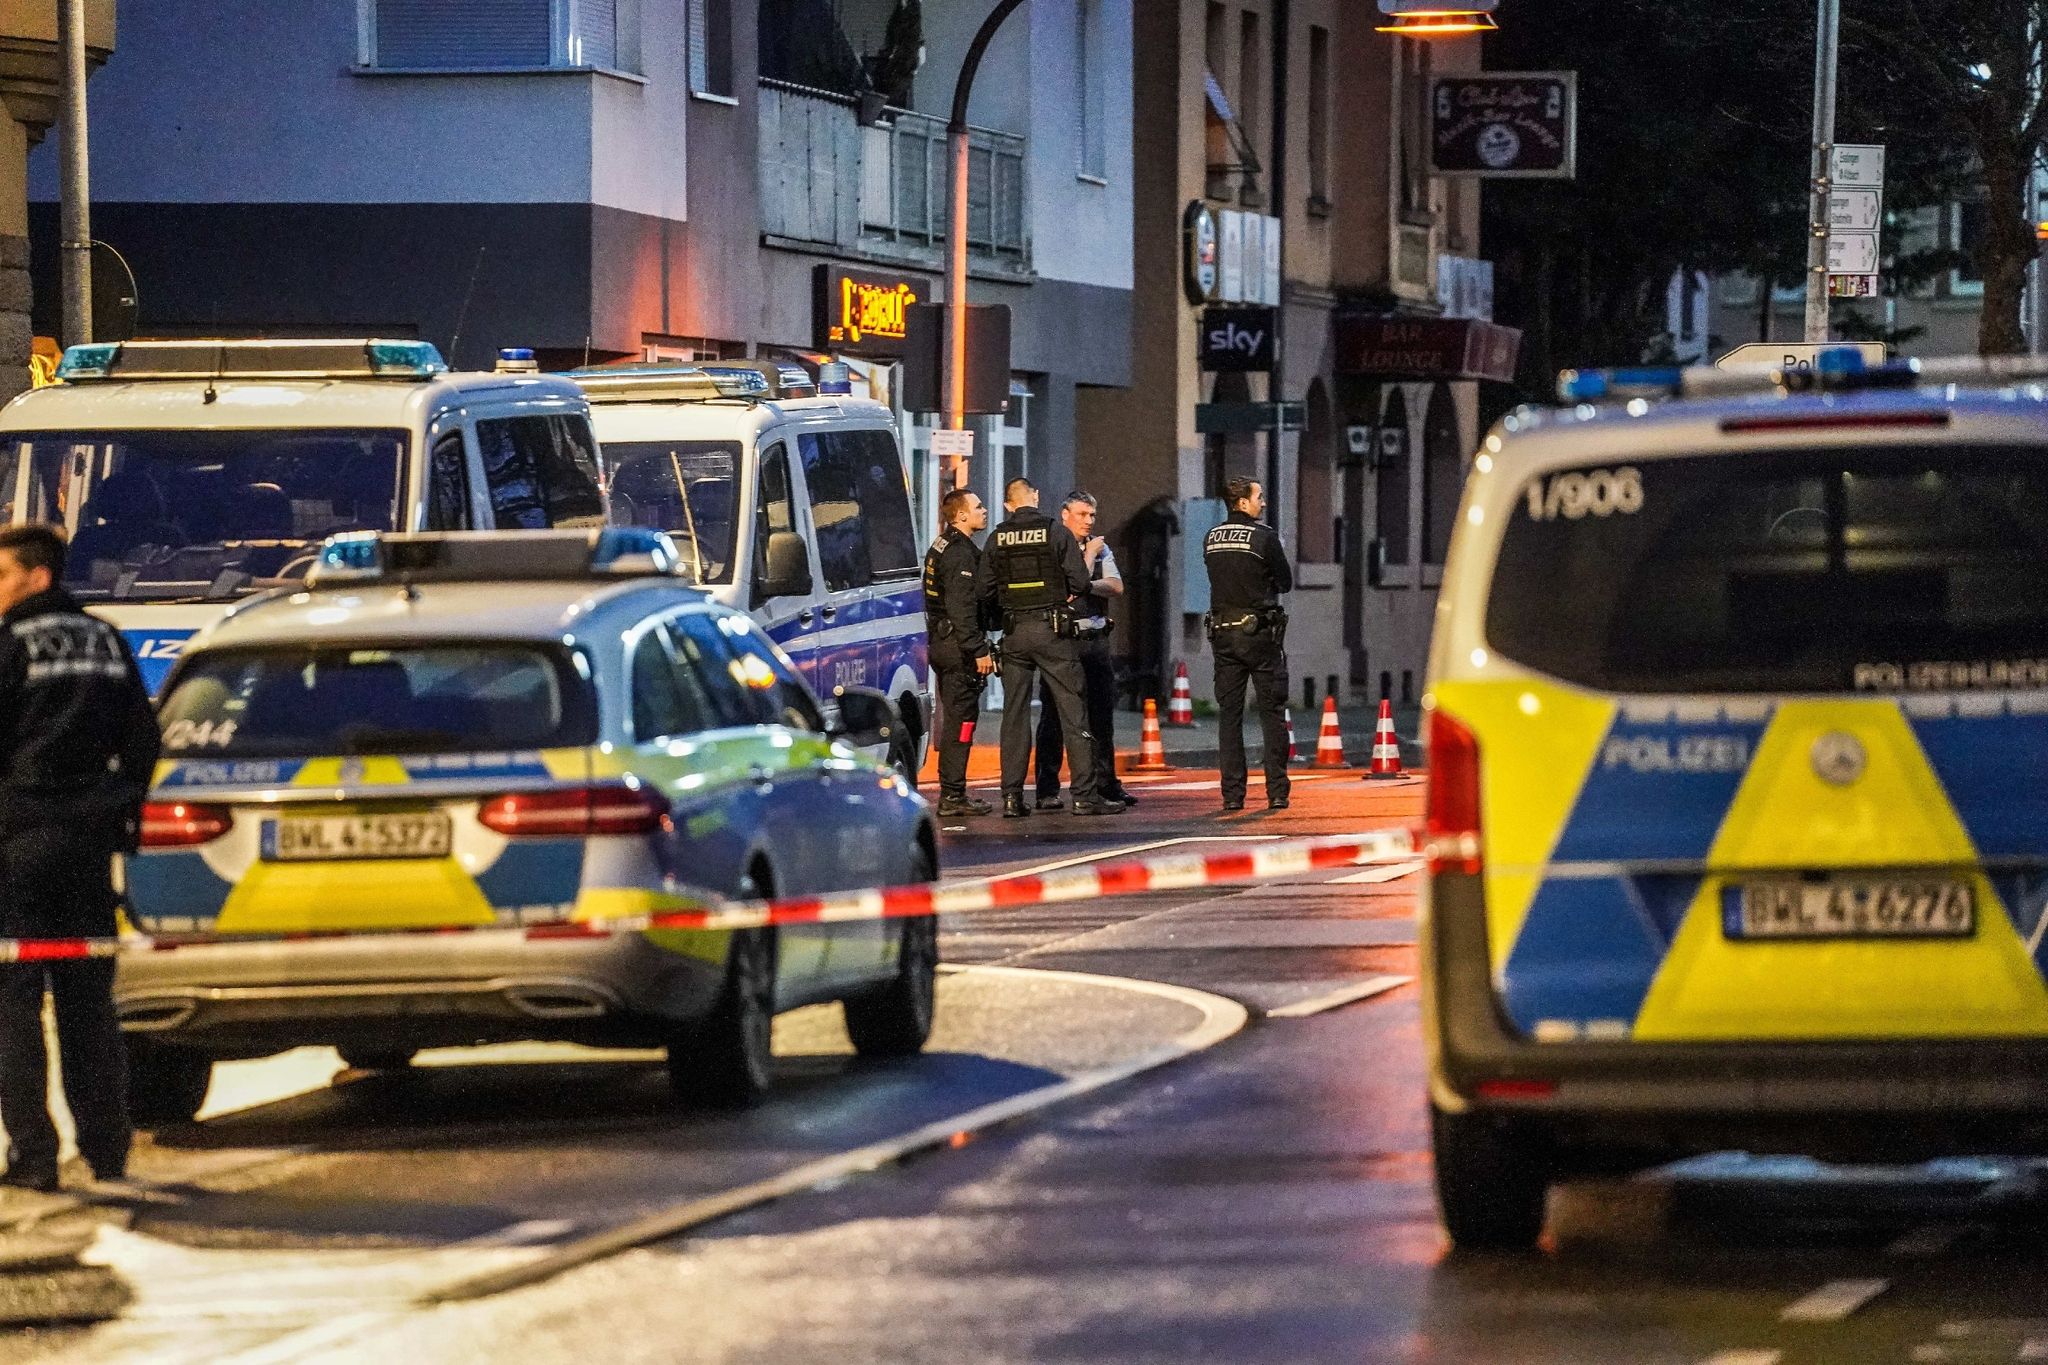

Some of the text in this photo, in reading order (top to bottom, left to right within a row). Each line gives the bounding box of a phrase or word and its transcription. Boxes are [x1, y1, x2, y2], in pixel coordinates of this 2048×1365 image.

[1209, 322, 1265, 357] sky
[1382, 323, 1424, 343] BAR
[1359, 347, 1443, 370] LOUNGE
[997, 529, 1047, 547] POLIZEI
[1207, 529, 1252, 544] POLIZEI
[1604, 736, 1748, 772] POLIZEI
